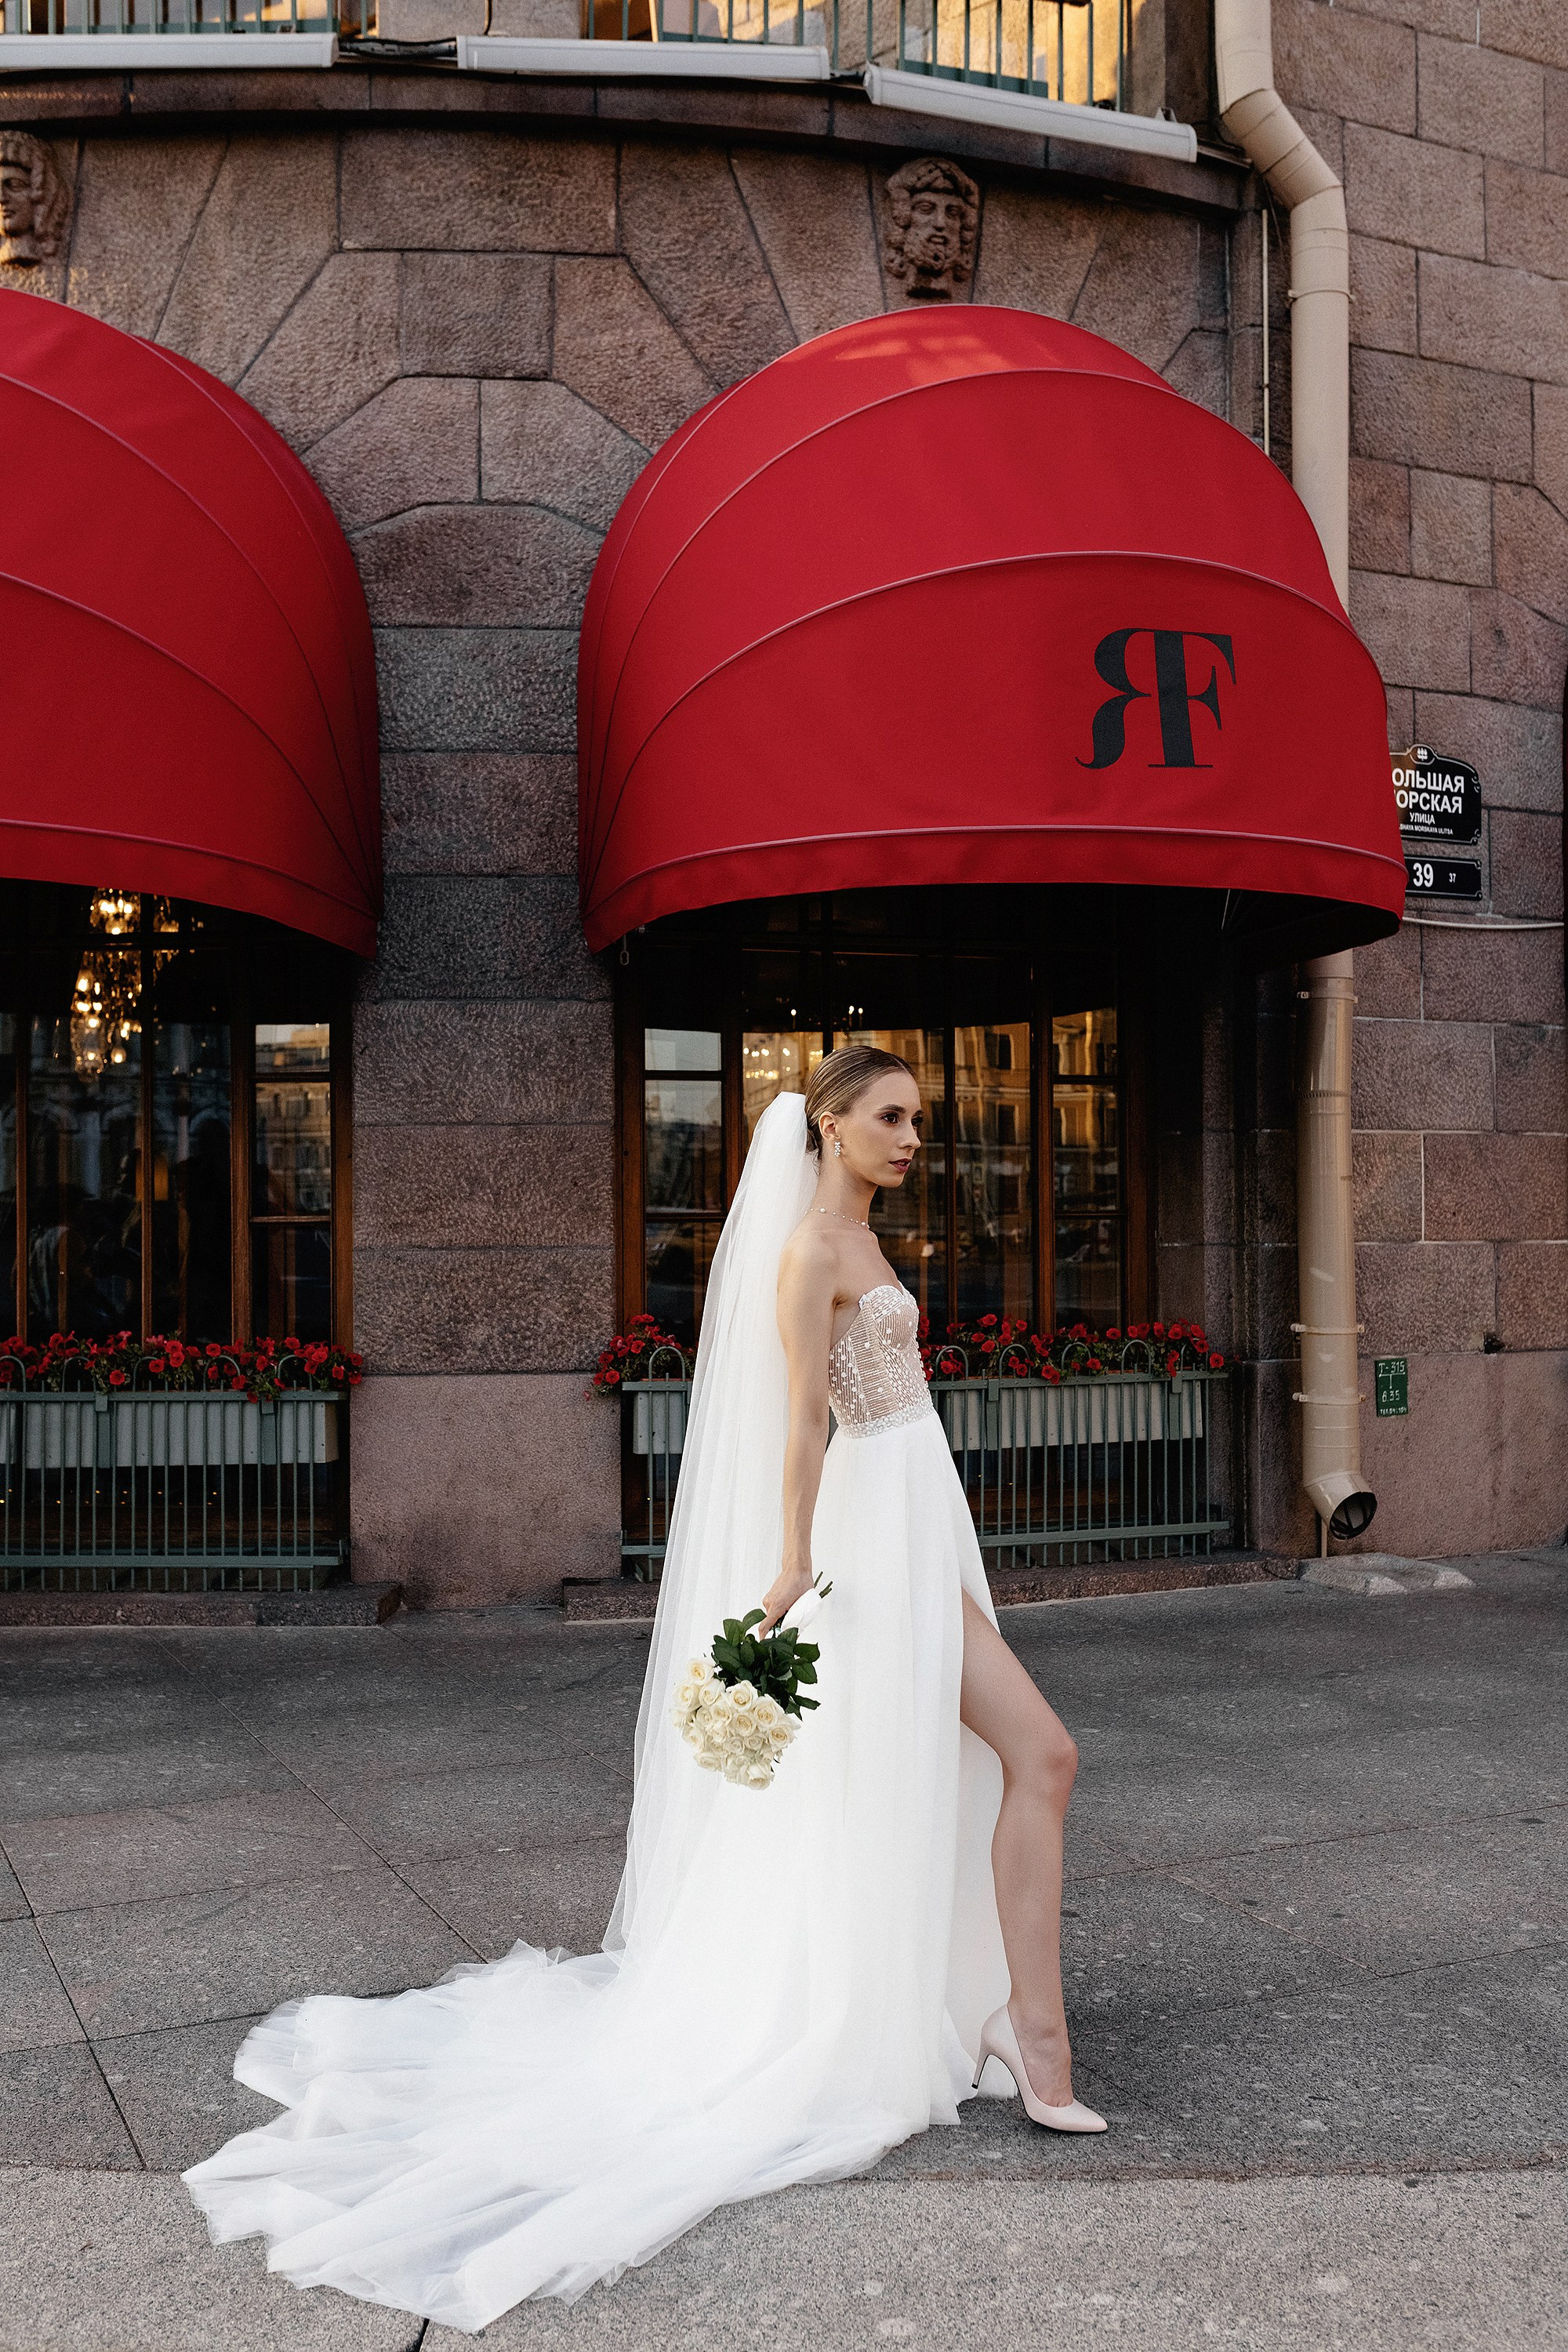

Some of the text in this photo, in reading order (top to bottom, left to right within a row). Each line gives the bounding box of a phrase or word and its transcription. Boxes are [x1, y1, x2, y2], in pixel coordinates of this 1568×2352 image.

[1392, 768, 1465, 793] ОЛЬШАЯ
[1394, 789, 1462, 814] ОРСКАЯ
[1410, 811, 1436, 825] УЛИЦА
[1413, 862, 1457, 887] 39 37
